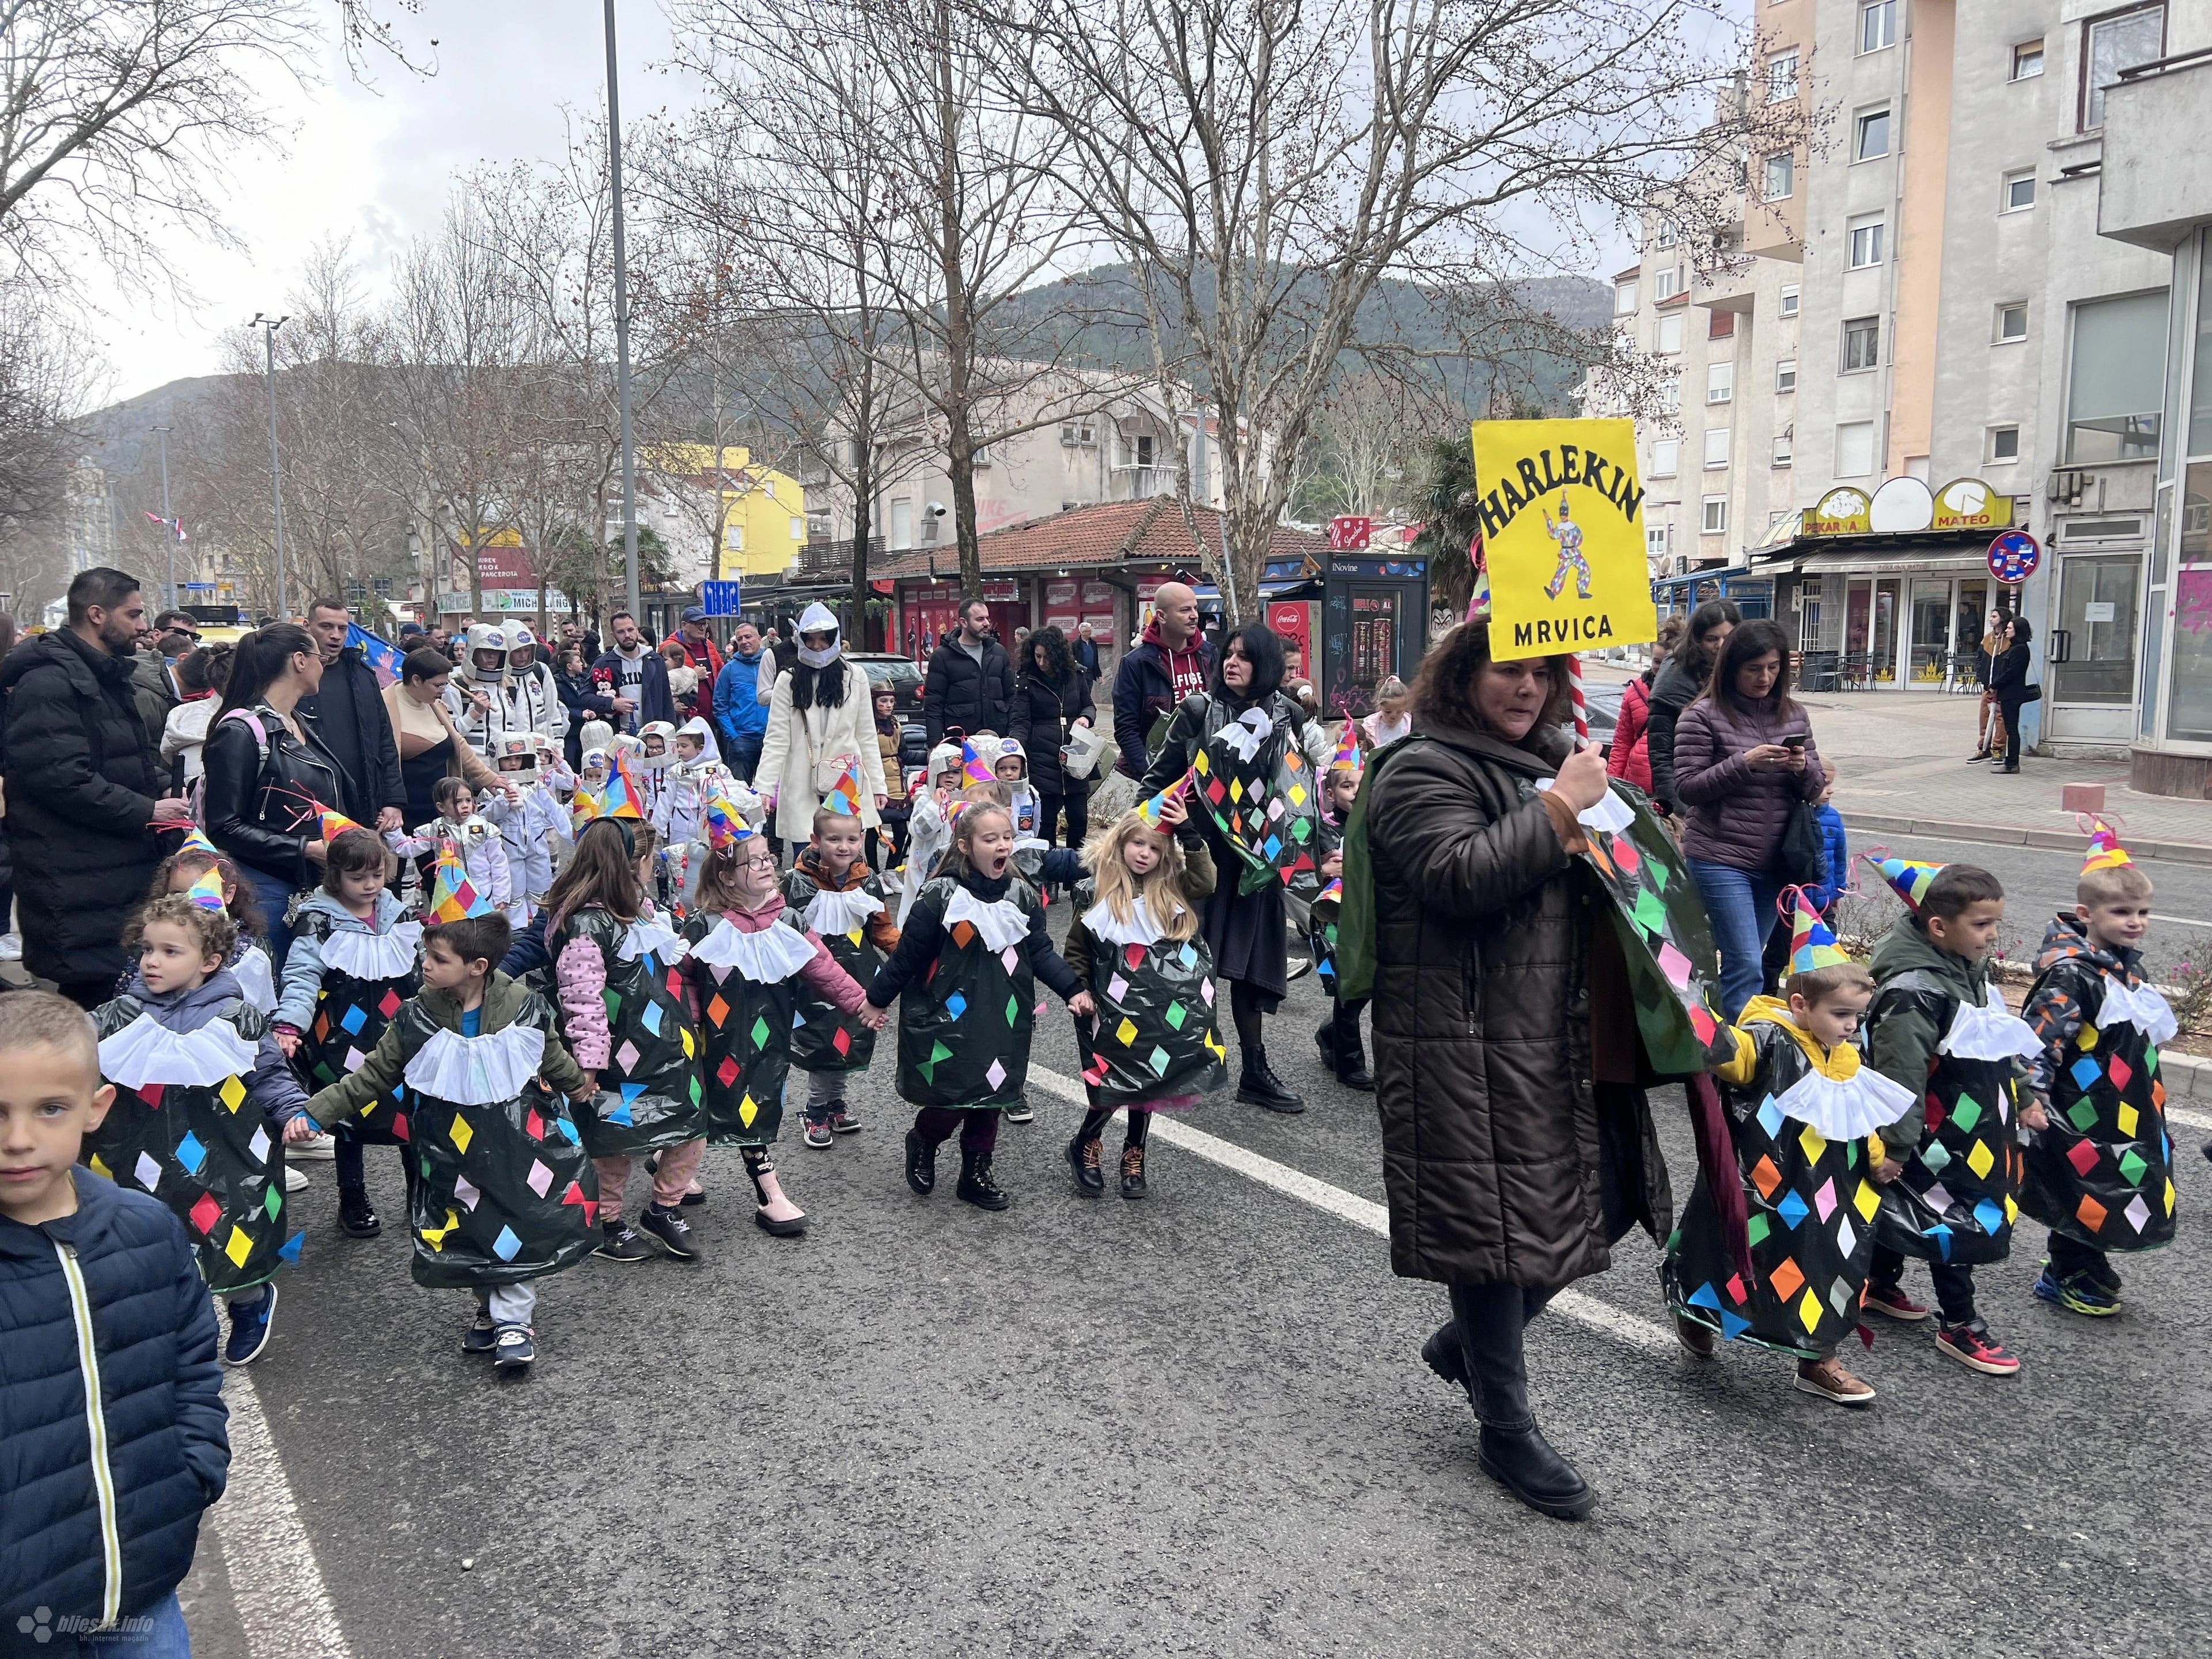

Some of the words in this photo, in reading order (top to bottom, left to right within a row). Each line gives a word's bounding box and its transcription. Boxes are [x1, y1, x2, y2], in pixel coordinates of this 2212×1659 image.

[1476, 444, 1645, 539] HARLEKIN
[1938, 514, 1990, 527] MATEO
[1278, 615, 1298, 623] Coca-Cola
[1514, 614, 1613, 647] MRVICA
